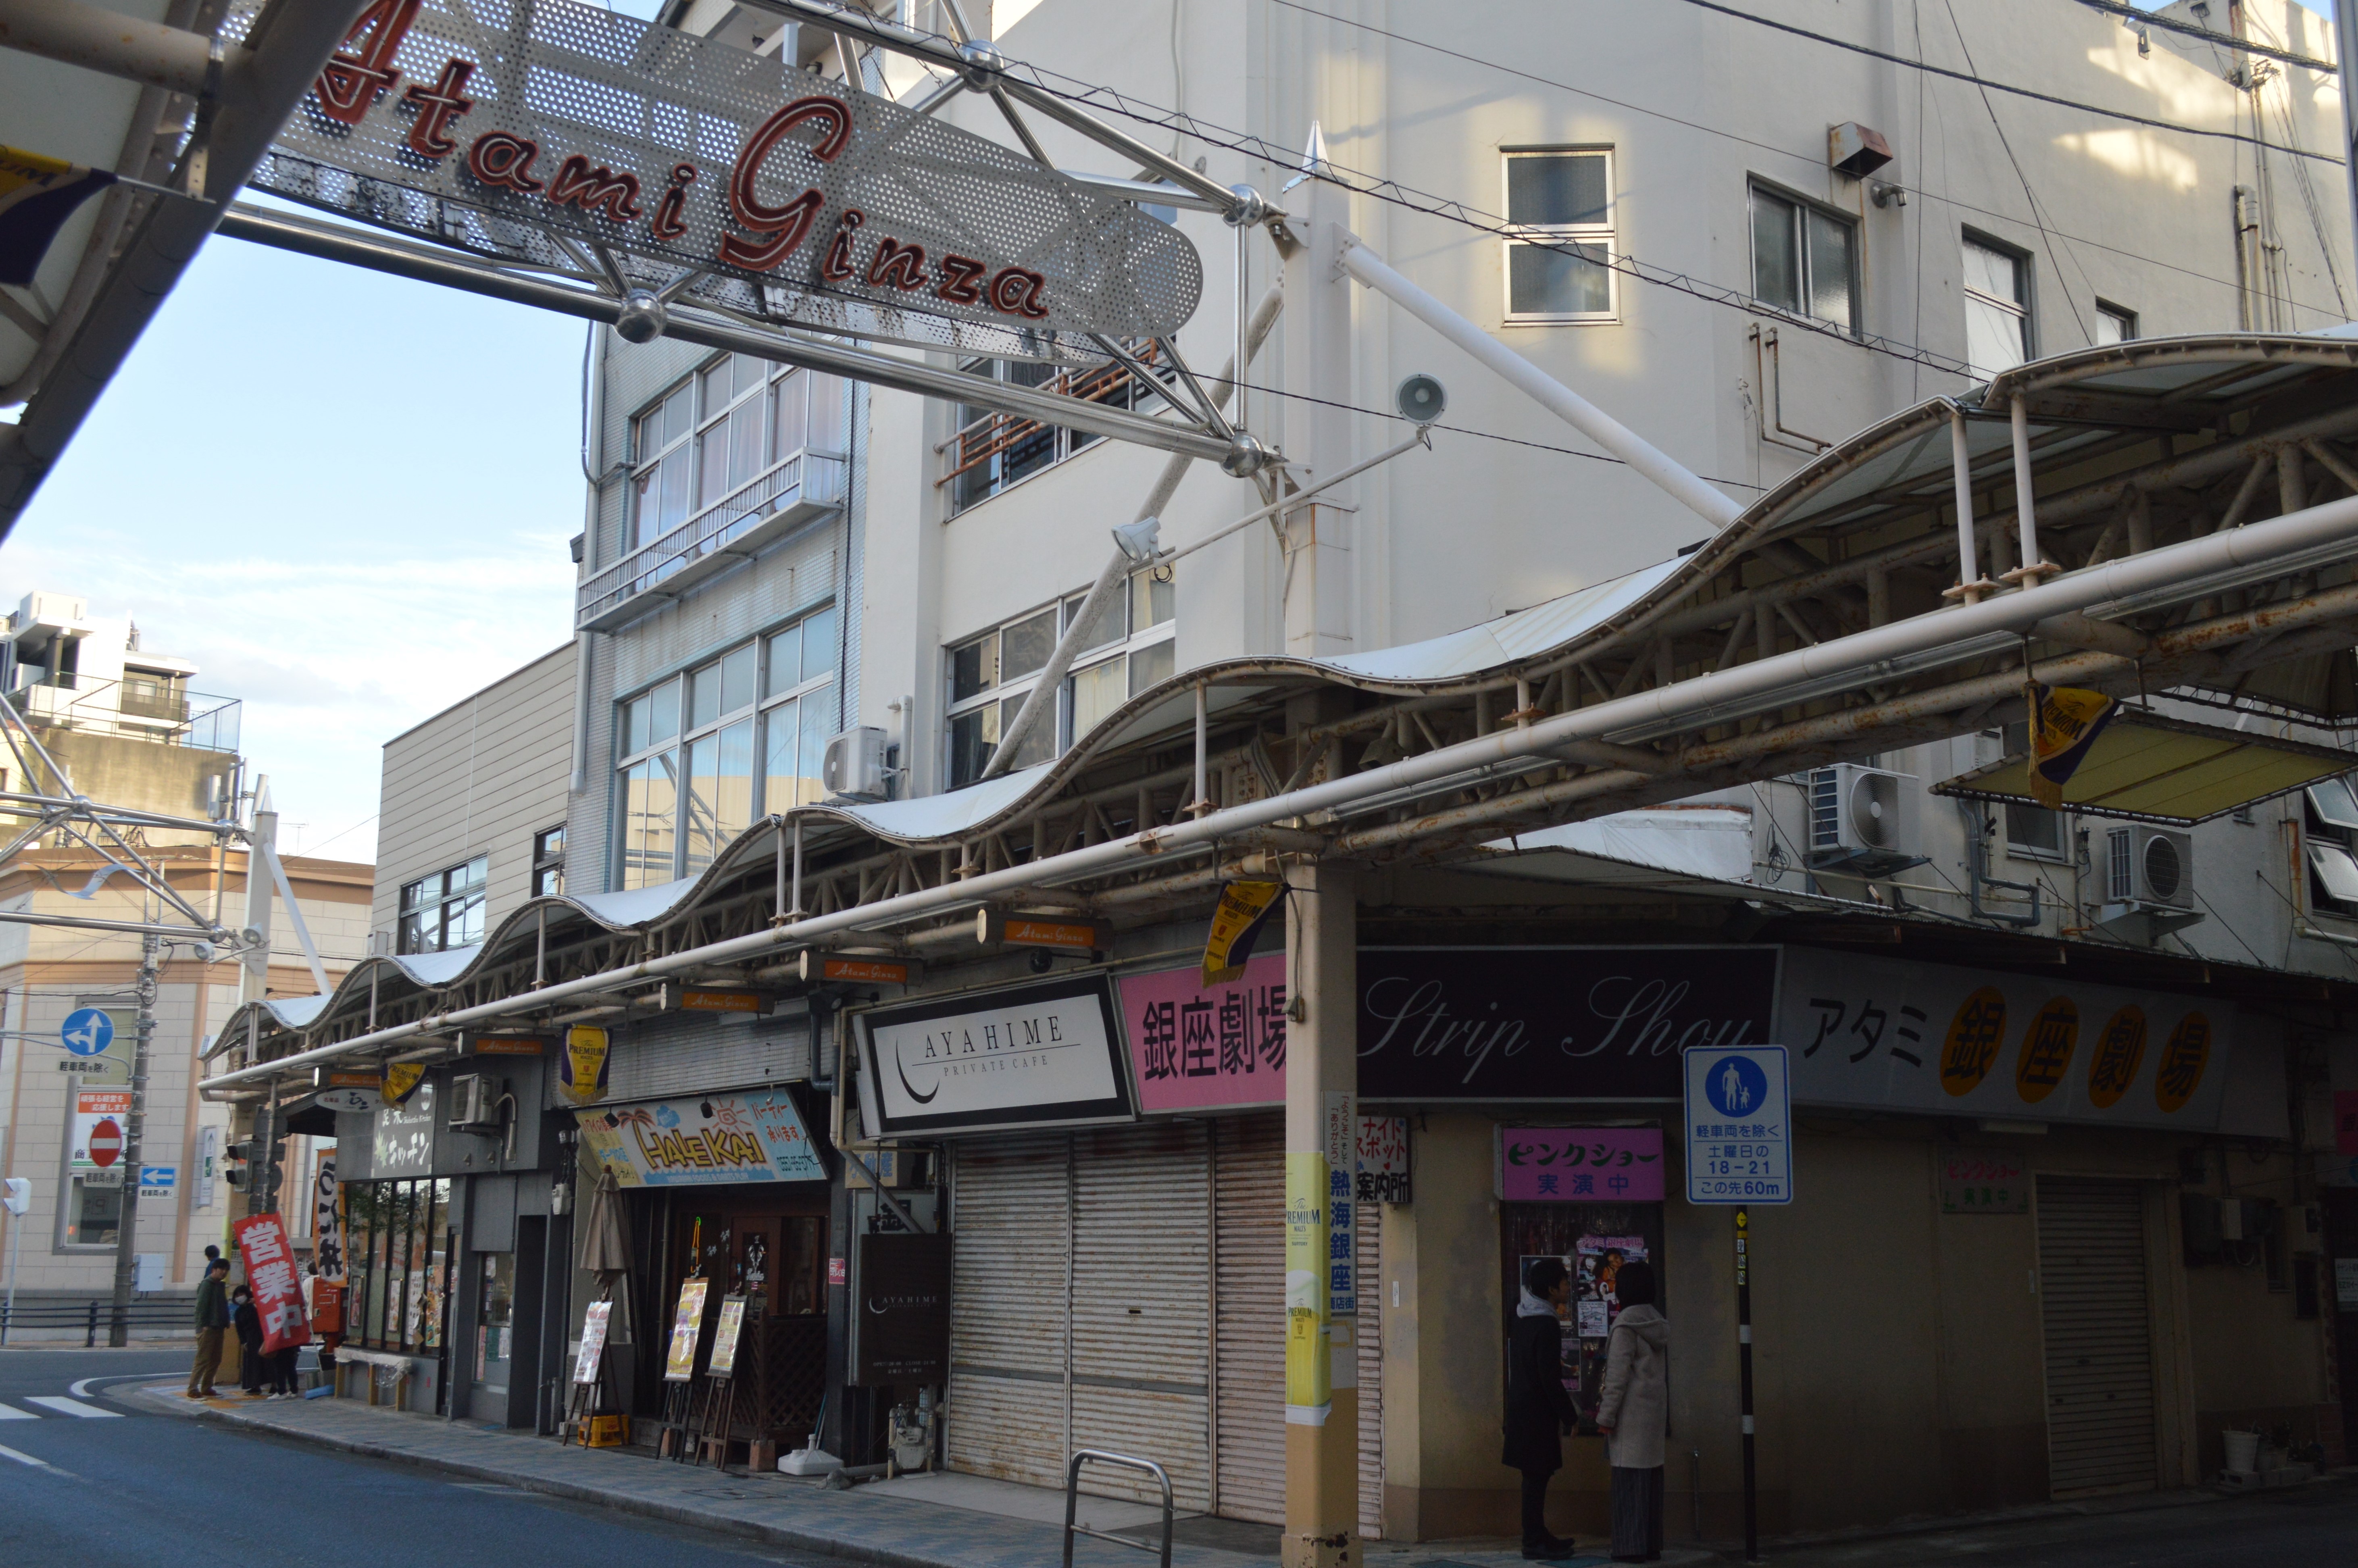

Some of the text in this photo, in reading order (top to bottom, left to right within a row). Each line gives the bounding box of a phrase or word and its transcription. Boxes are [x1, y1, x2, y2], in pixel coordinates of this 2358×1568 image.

[718, 96, 1048, 319] Ginza
[1221, 890, 1263, 919] PREMIUM
[1016, 924, 1083, 942] Atami Ginza
[835, 963, 897, 978] Atami Ginza
[692, 994, 749, 1007] Atami Ginza
[926, 1016, 1062, 1058] AYAHIME
[1142, 985, 1286, 1082] 銀座劇場
[1357, 976, 1530, 1084] Strip
[569, 1043, 605, 1056] PREMIUM
[1804, 996, 2208, 1098] アタミ銀座劇場
[59, 1061, 108, 1073] 軽車両を除く
[944, 1055, 1047, 1076] PRIVATE CAFE
[1363, 1117, 1401, 1140] ナイト
[1696, 1124, 1779, 1138] 軽車両を除く
[389, 1133, 429, 1168] キッチン
[1357, 1137, 1405, 1162] スポット
[1508, 1142, 1660, 1168] ピンクショー
[1708, 1145, 1769, 1158] 土曜日の
[86, 1173, 120, 1183] 軽車両を除く
[1357, 1171, 1408, 1202] 案内所
[1537, 1174, 1629, 1196] 実演中
[1701, 1181, 1780, 1195] この先60m
[1291, 1197, 1309, 1210] The
[1330, 1170, 1351, 1291] 熱海銀座
[241, 1221, 303, 1339] 営業中
[1288, 1307, 1312, 1318] PREMIUM
